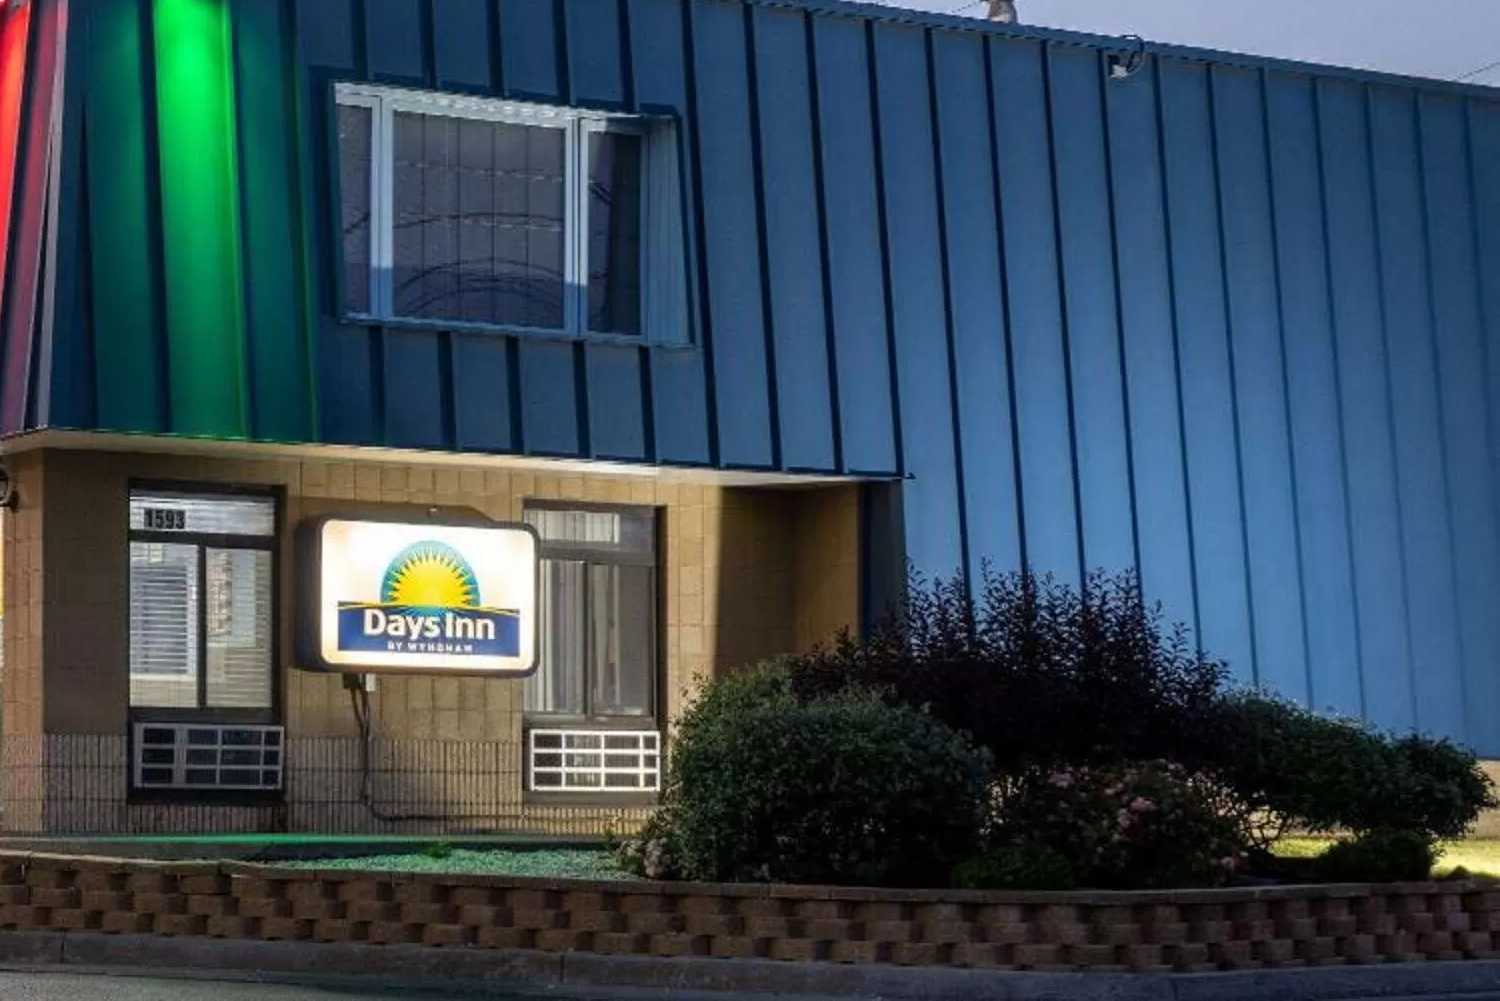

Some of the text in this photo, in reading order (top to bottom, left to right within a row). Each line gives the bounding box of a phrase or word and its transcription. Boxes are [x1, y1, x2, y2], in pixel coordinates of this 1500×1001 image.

[143, 509, 186, 529] 1593
[363, 609, 496, 640] Days Inn
[387, 641, 402, 650] BY
